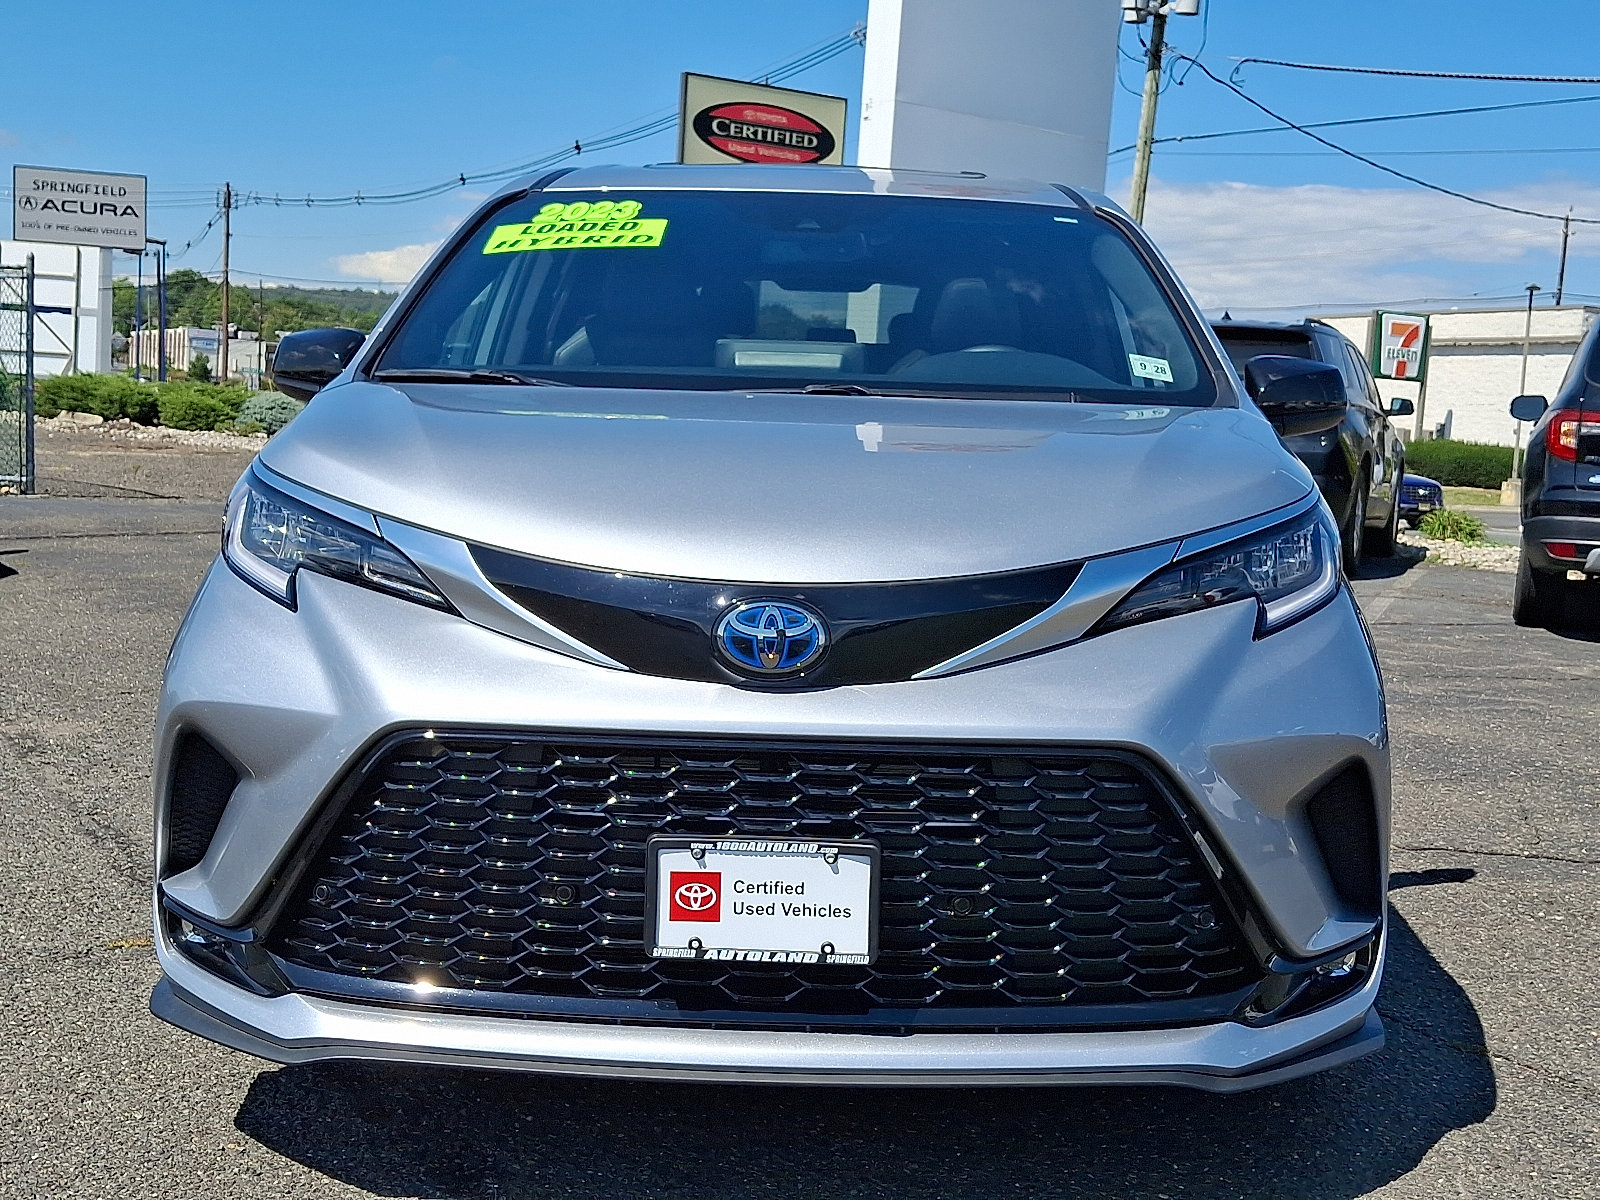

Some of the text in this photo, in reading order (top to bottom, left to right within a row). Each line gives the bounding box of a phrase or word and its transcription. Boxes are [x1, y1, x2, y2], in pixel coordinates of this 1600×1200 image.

[711, 118, 819, 148] CERTIFIED
[32, 179, 127, 197] SPRINGFIELD
[40, 199, 139, 218] ACURA
[532, 200, 643, 222] 2023
[101, 227, 138, 237] VEHICLES
[520, 221, 641, 236] LOADED
[493, 235, 656, 249] HYBRID
[1390, 321, 1421, 378] 7
[1139, 362, 1167, 375] 9 28
[733, 880, 806, 896] Certified
[733, 901, 852, 918] Used Vehicles
[652, 947, 870, 965] SPRINGFIELD AUTOLAND SPRINGFIELD
